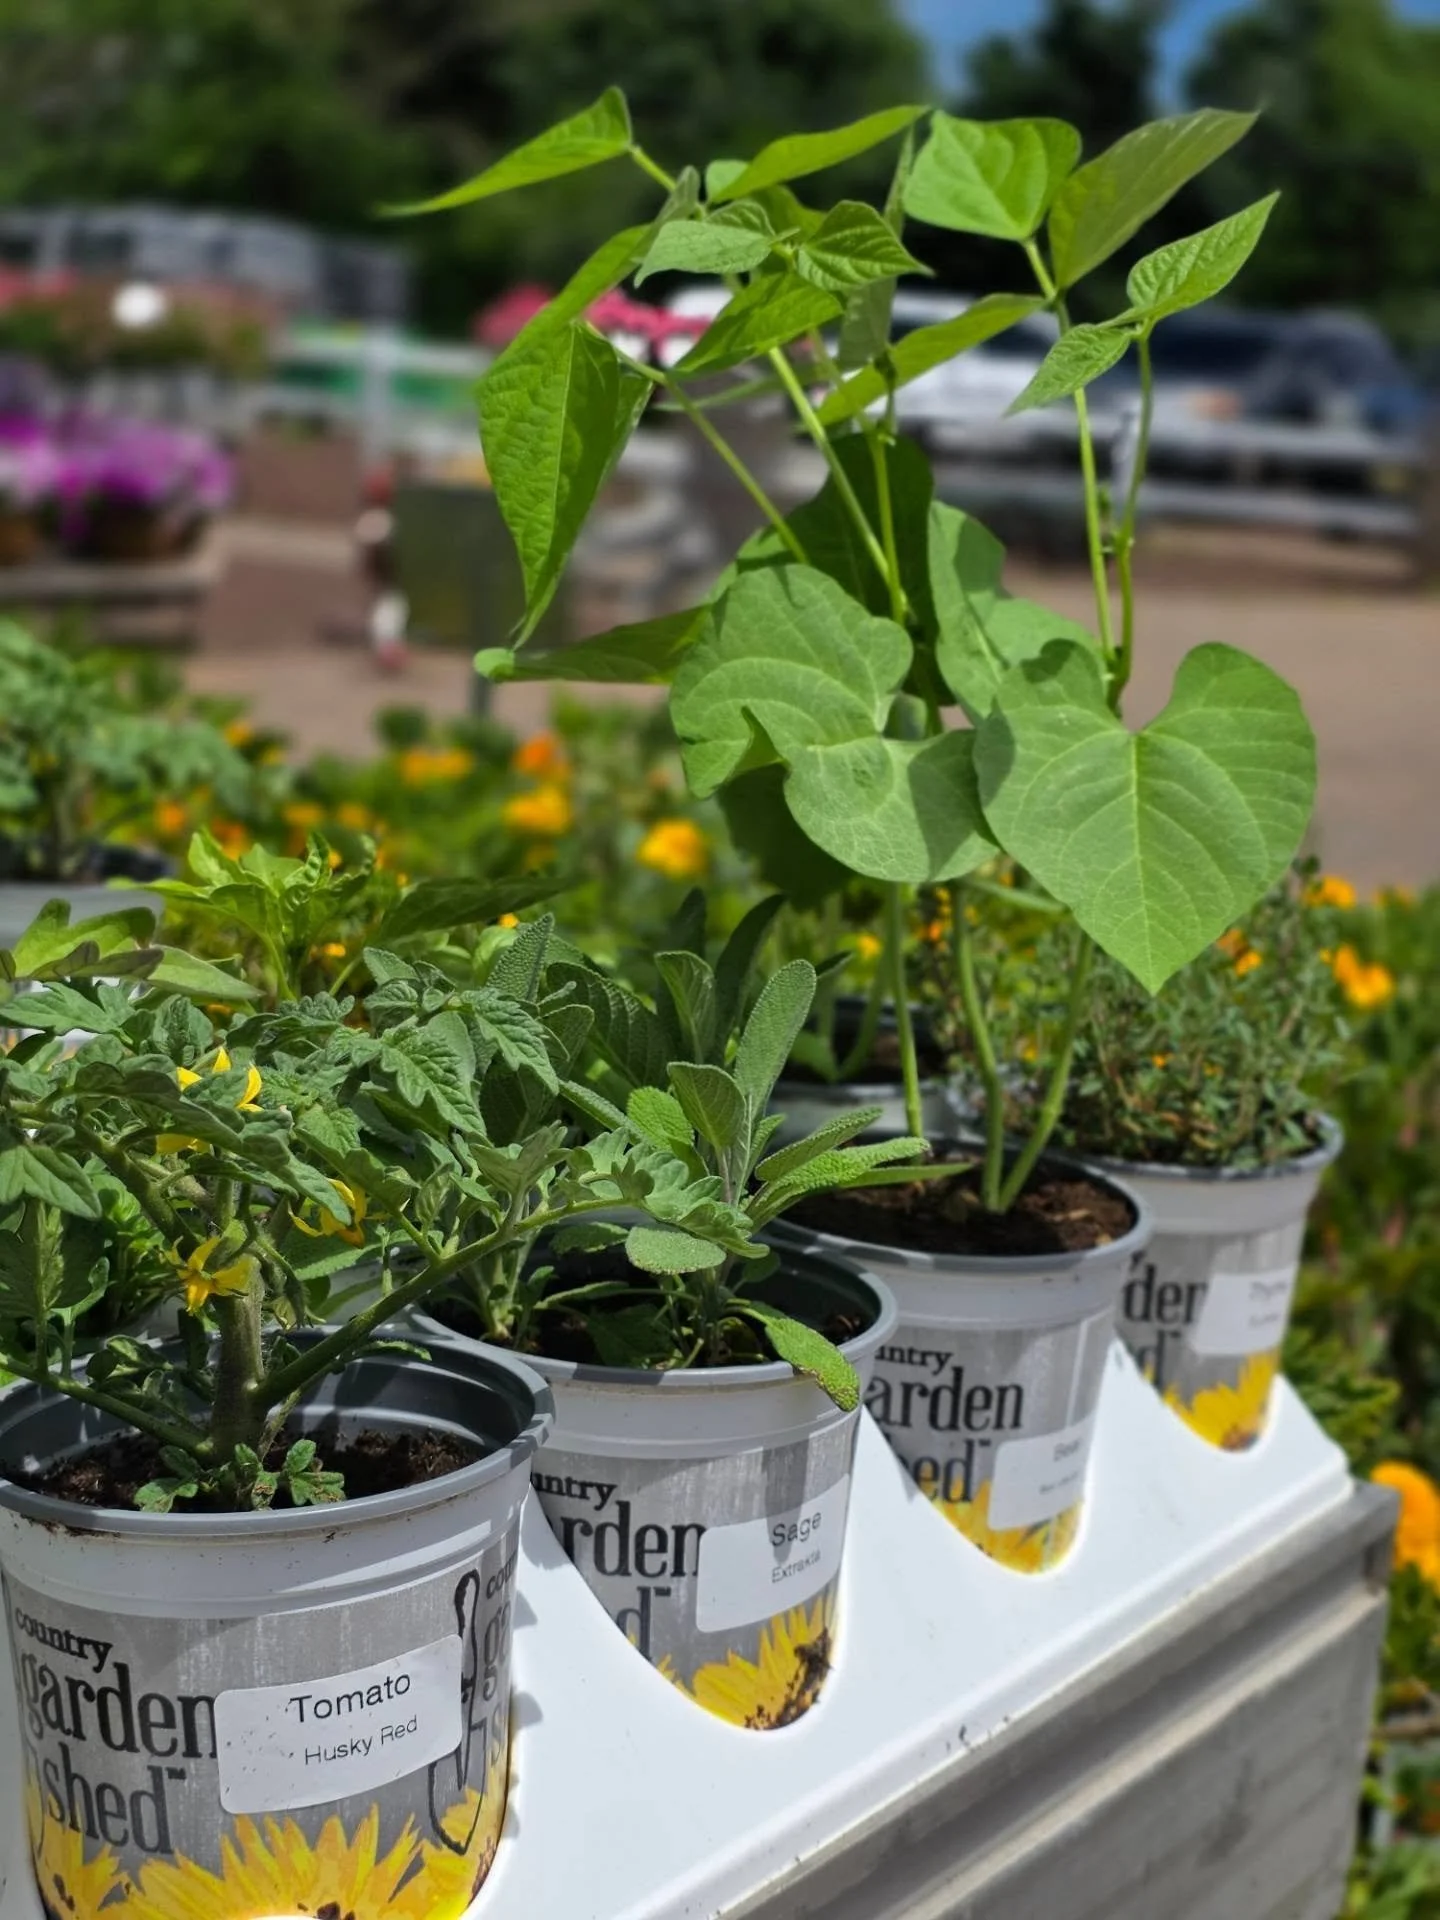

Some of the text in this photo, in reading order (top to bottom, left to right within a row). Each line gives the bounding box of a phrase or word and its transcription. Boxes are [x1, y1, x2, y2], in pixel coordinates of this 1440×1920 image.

[866, 1366, 1024, 1432] arden
[531, 1472, 618, 1511] untry
[560, 1500, 706, 1578] rden
[772, 1512, 822, 1547] Sage
[15, 1607, 113, 1674] country
[21, 1652, 218, 1760] garden
[289, 1674, 411, 1723] Tomato
[305, 1714, 418, 1765] Husky Red
